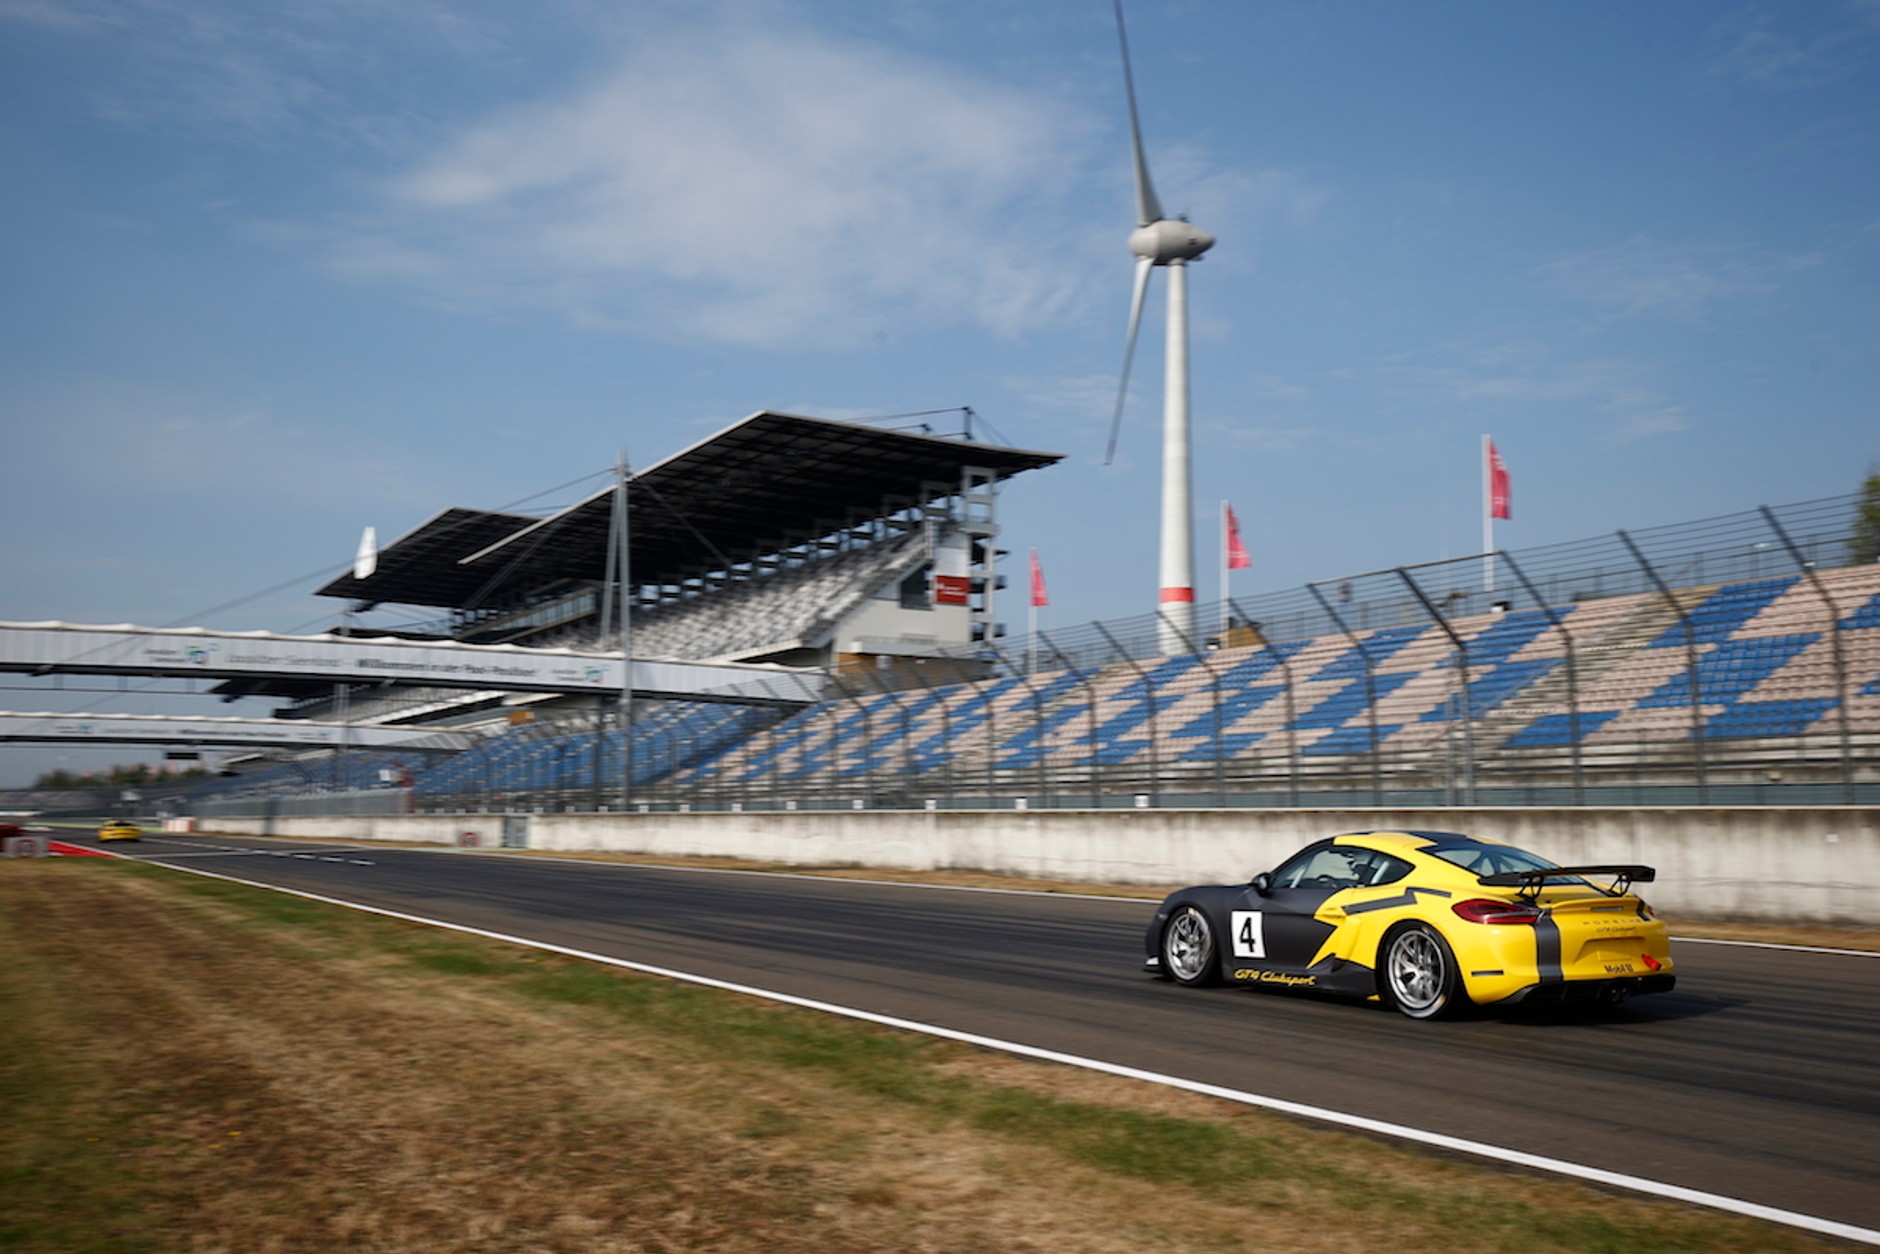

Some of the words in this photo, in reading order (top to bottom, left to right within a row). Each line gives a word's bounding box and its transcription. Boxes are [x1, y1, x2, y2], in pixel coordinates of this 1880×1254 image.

[1239, 917, 1255, 953] 4
[1234, 968, 1260, 980] GT4
[1260, 970, 1317, 986] Clubsport
